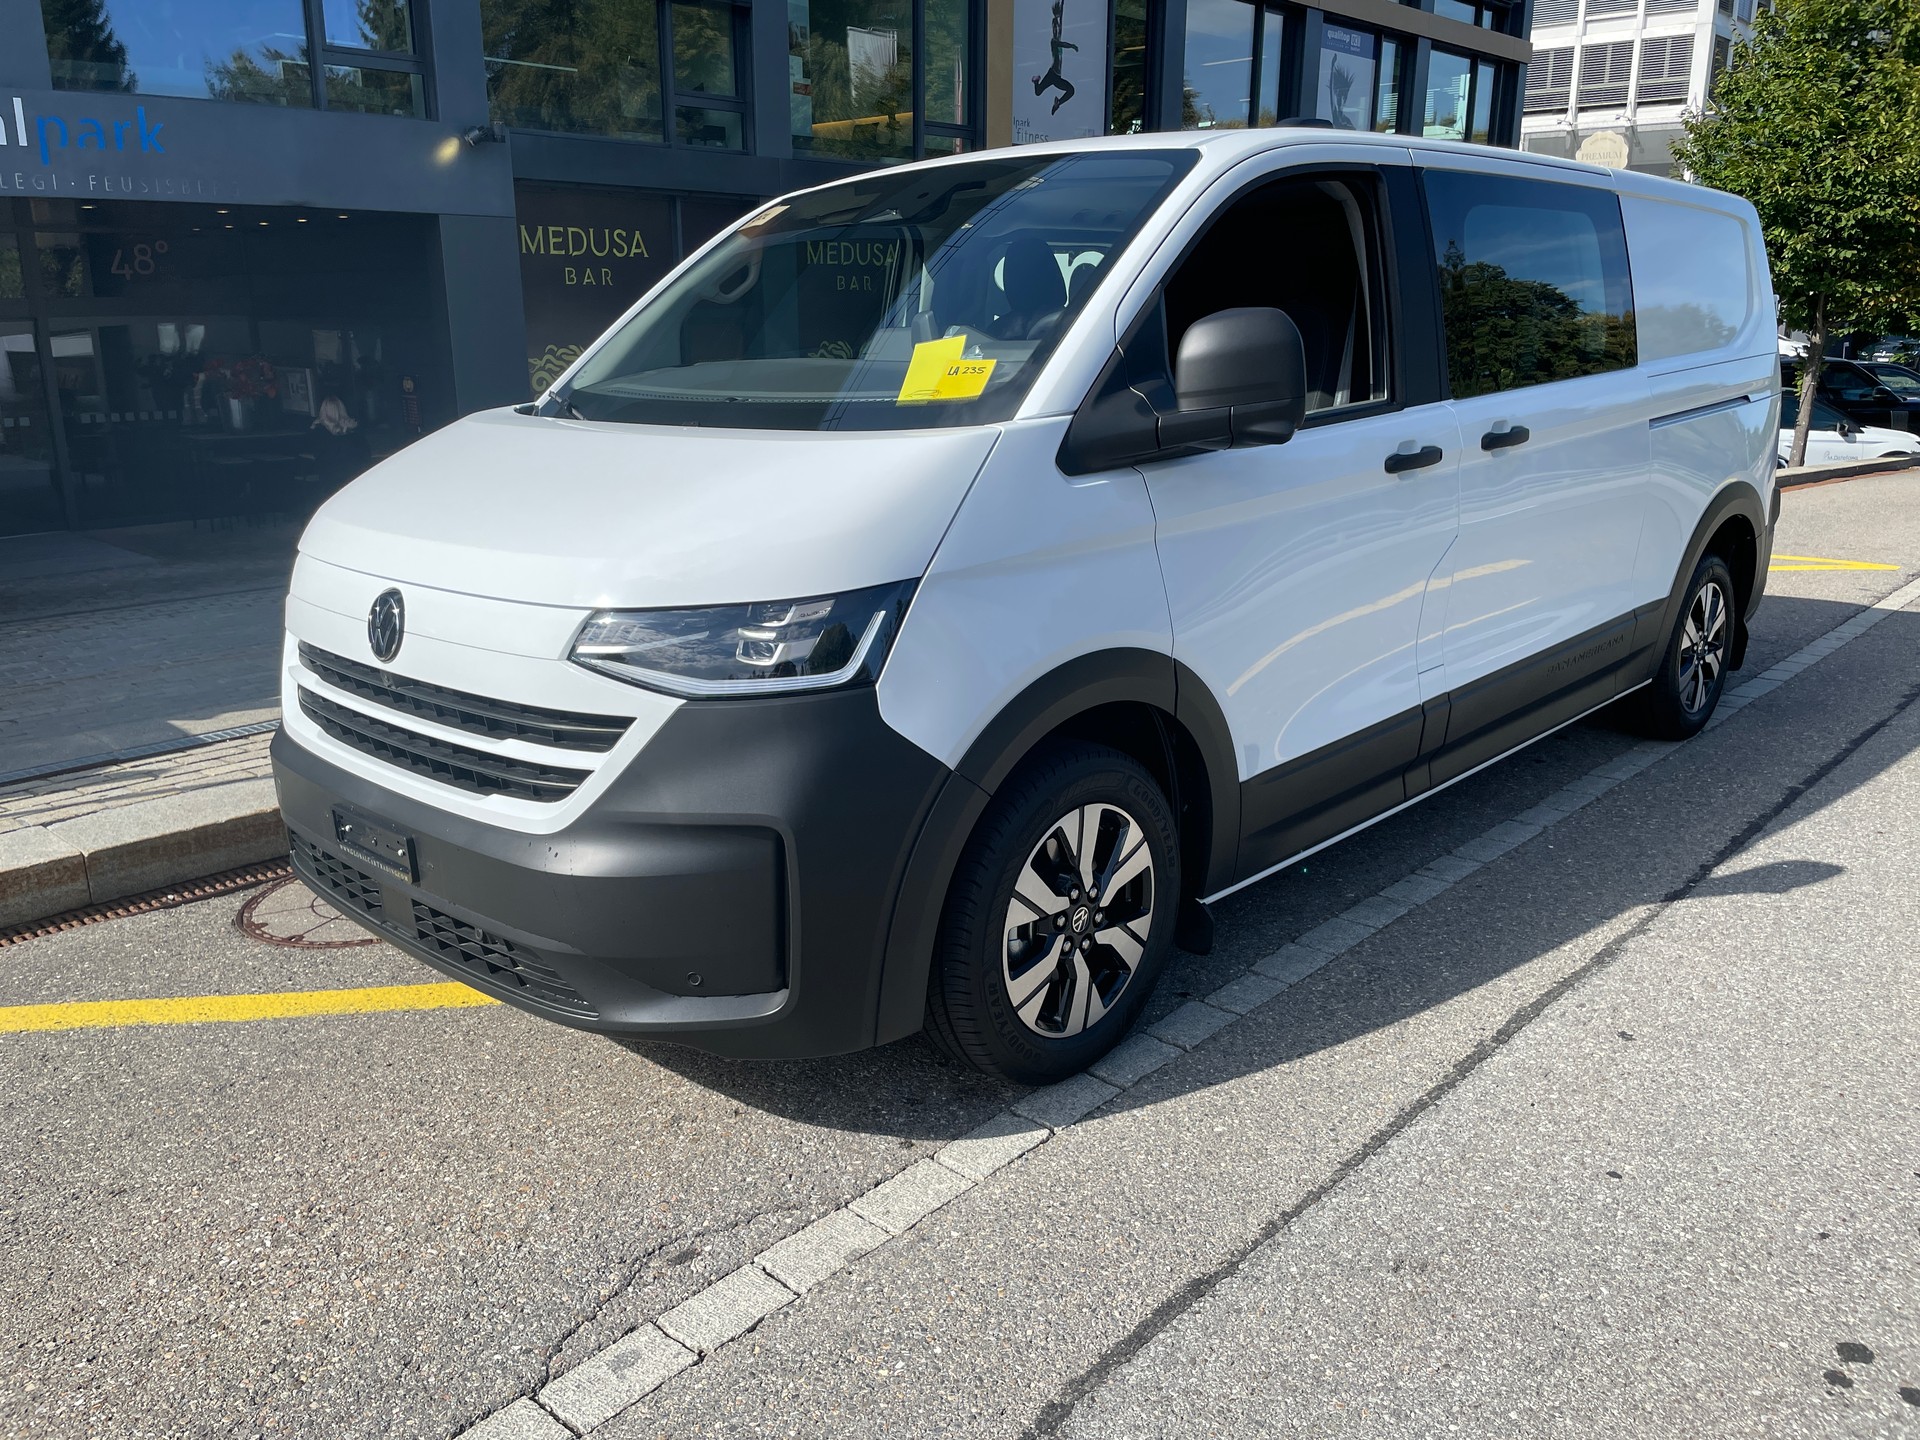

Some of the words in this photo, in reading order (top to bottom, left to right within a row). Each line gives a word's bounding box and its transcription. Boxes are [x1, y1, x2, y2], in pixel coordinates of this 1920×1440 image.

[1016, 127, 1049, 143] fitness
[88, 174, 242, 197] FEUSISBE
[519, 224, 650, 258] MEDUSA
[806, 240, 897, 266] MEDUSA
[564, 267, 614, 286] BAR
[837, 275, 872, 291] BAR
[947, 366, 961, 376] LA
